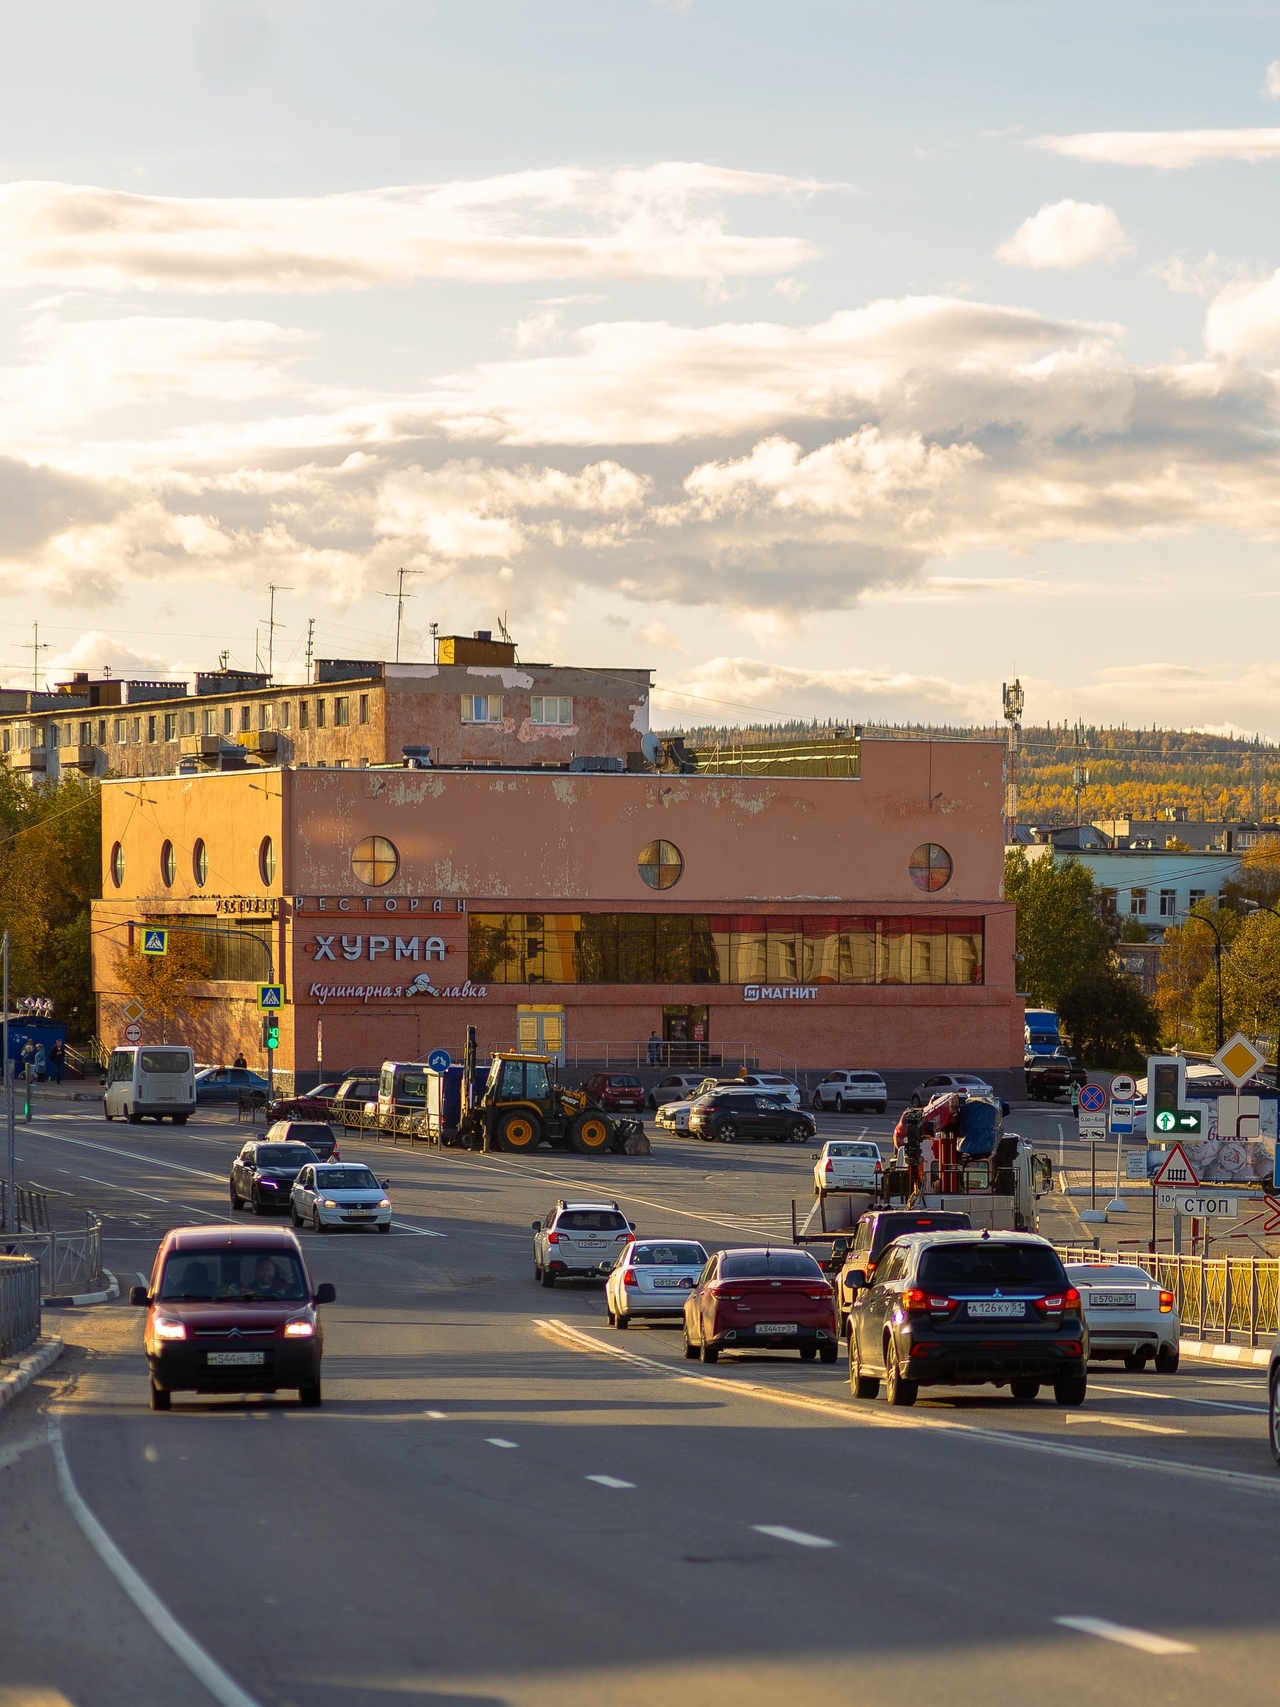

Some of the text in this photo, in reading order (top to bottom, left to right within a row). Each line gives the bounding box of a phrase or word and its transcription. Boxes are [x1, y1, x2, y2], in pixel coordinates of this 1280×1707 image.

[295, 898, 466, 912] РЕСТОРАН
[313, 935, 446, 961] ХУРМА
[310, 980, 488, 1005] Кулинарная лавка
[761, 987, 818, 999] МАГНИТ
[1184, 1199, 1230, 1214] СТОП
[971, 1302, 1022, 1313] А126КУ 51
[210, 1354, 249, 1363] М544МС
